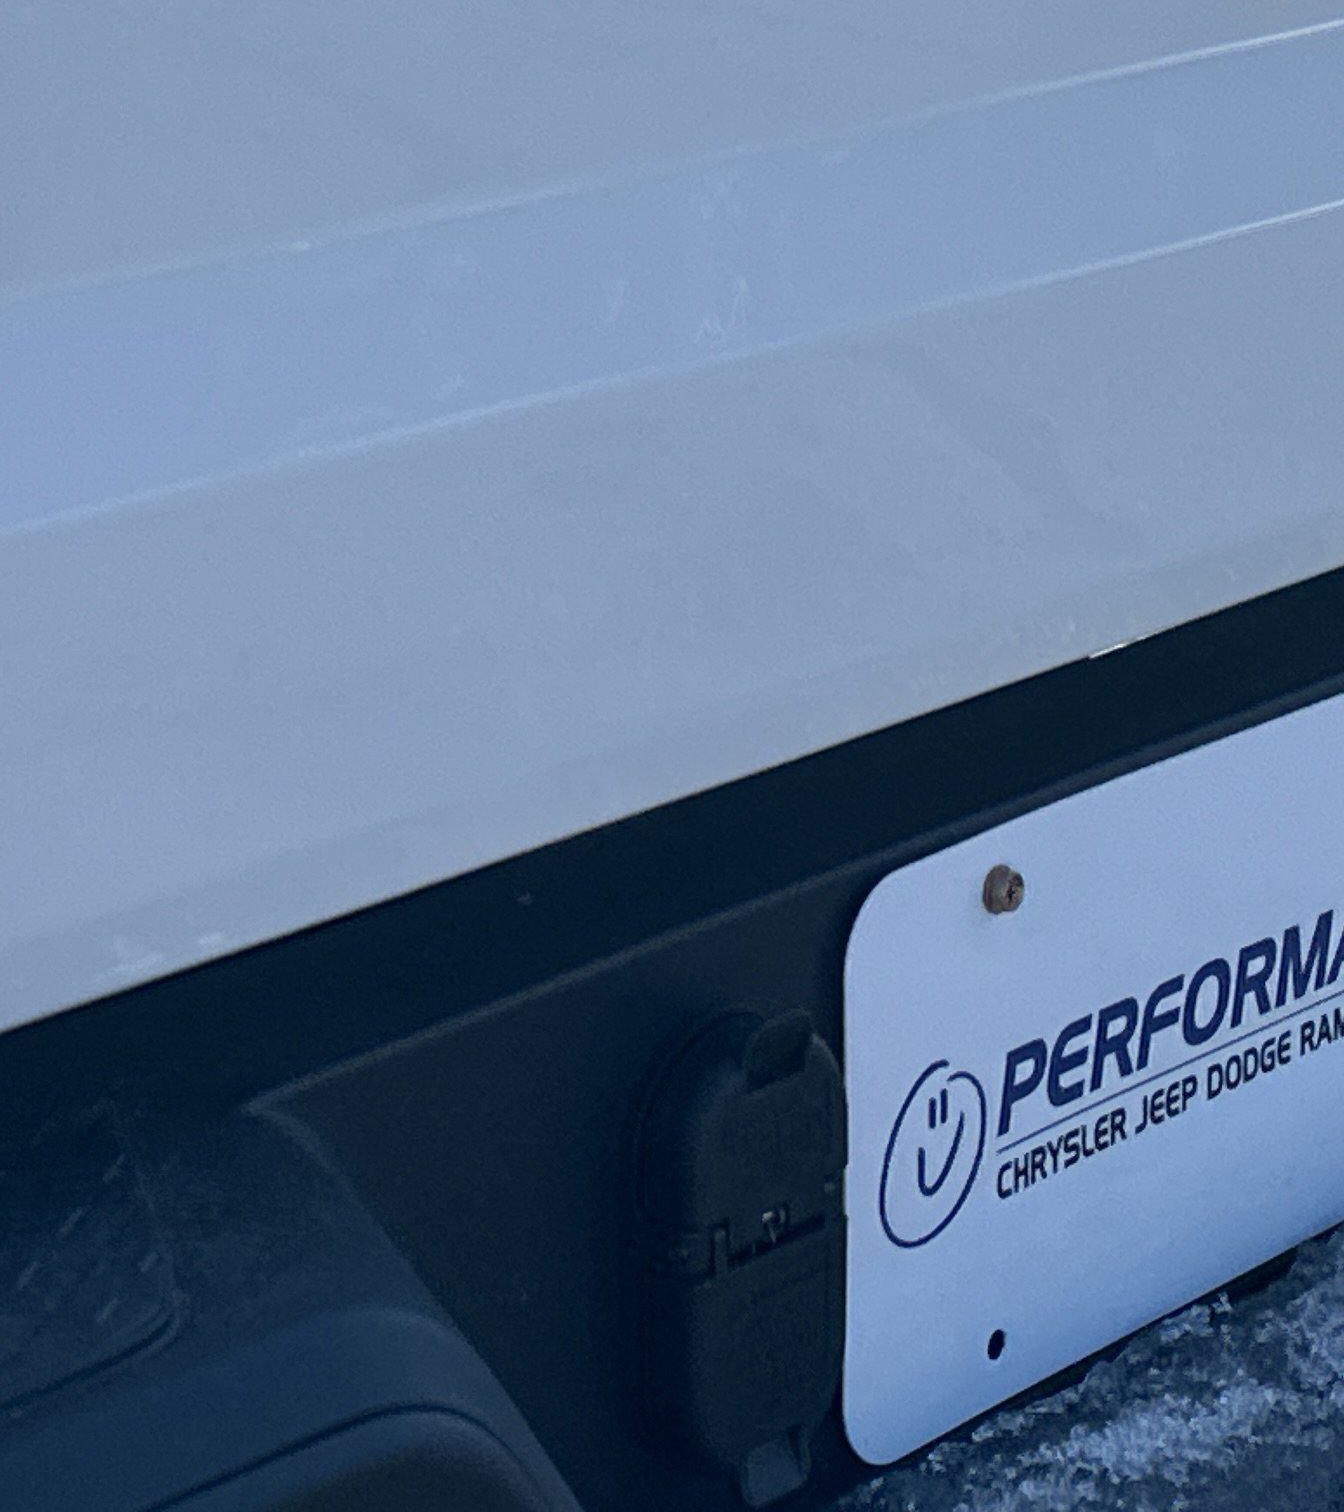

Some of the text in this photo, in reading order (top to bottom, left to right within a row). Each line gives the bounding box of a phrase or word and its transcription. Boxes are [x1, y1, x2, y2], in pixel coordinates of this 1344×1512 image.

[997, 1107, 1128, 1200] CHRYSLER
[1134, 1075, 1199, 1135] JEEP
[1206, 1037, 1292, 1102] DODGE
